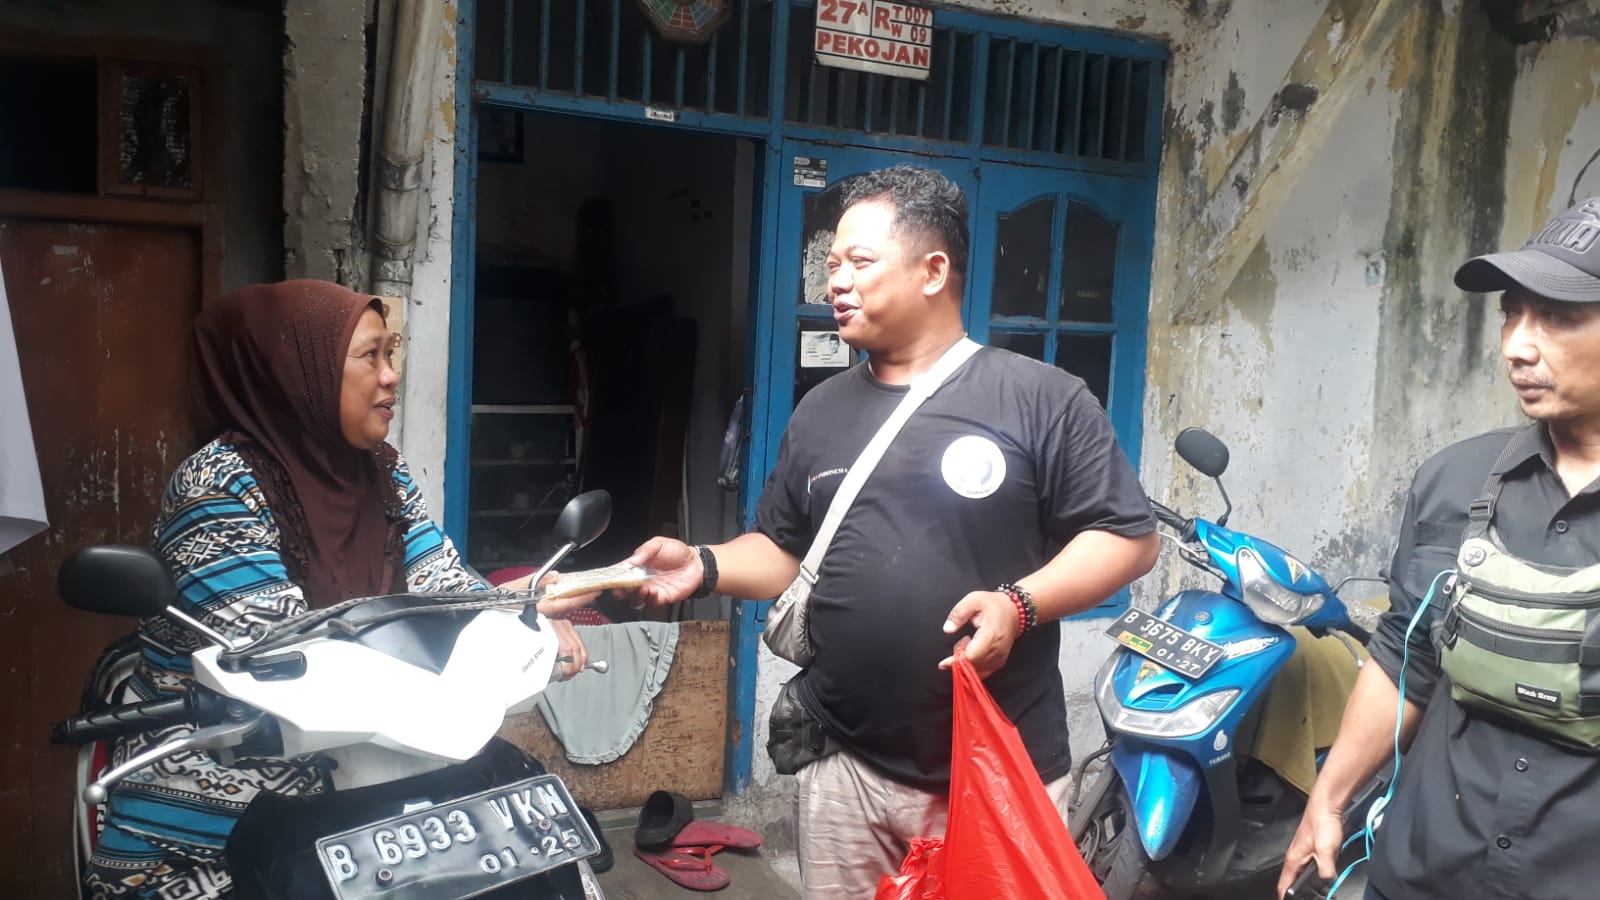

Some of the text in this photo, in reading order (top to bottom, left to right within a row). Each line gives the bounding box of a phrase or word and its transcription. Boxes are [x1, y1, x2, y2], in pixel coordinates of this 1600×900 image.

[817, 31, 928, 67] PEKOJAN
[1124, 611, 1140, 624] B
[1140, 619, 1183, 645] 3675
[326, 844, 359, 883] B
[373, 809, 477, 865] 6933
